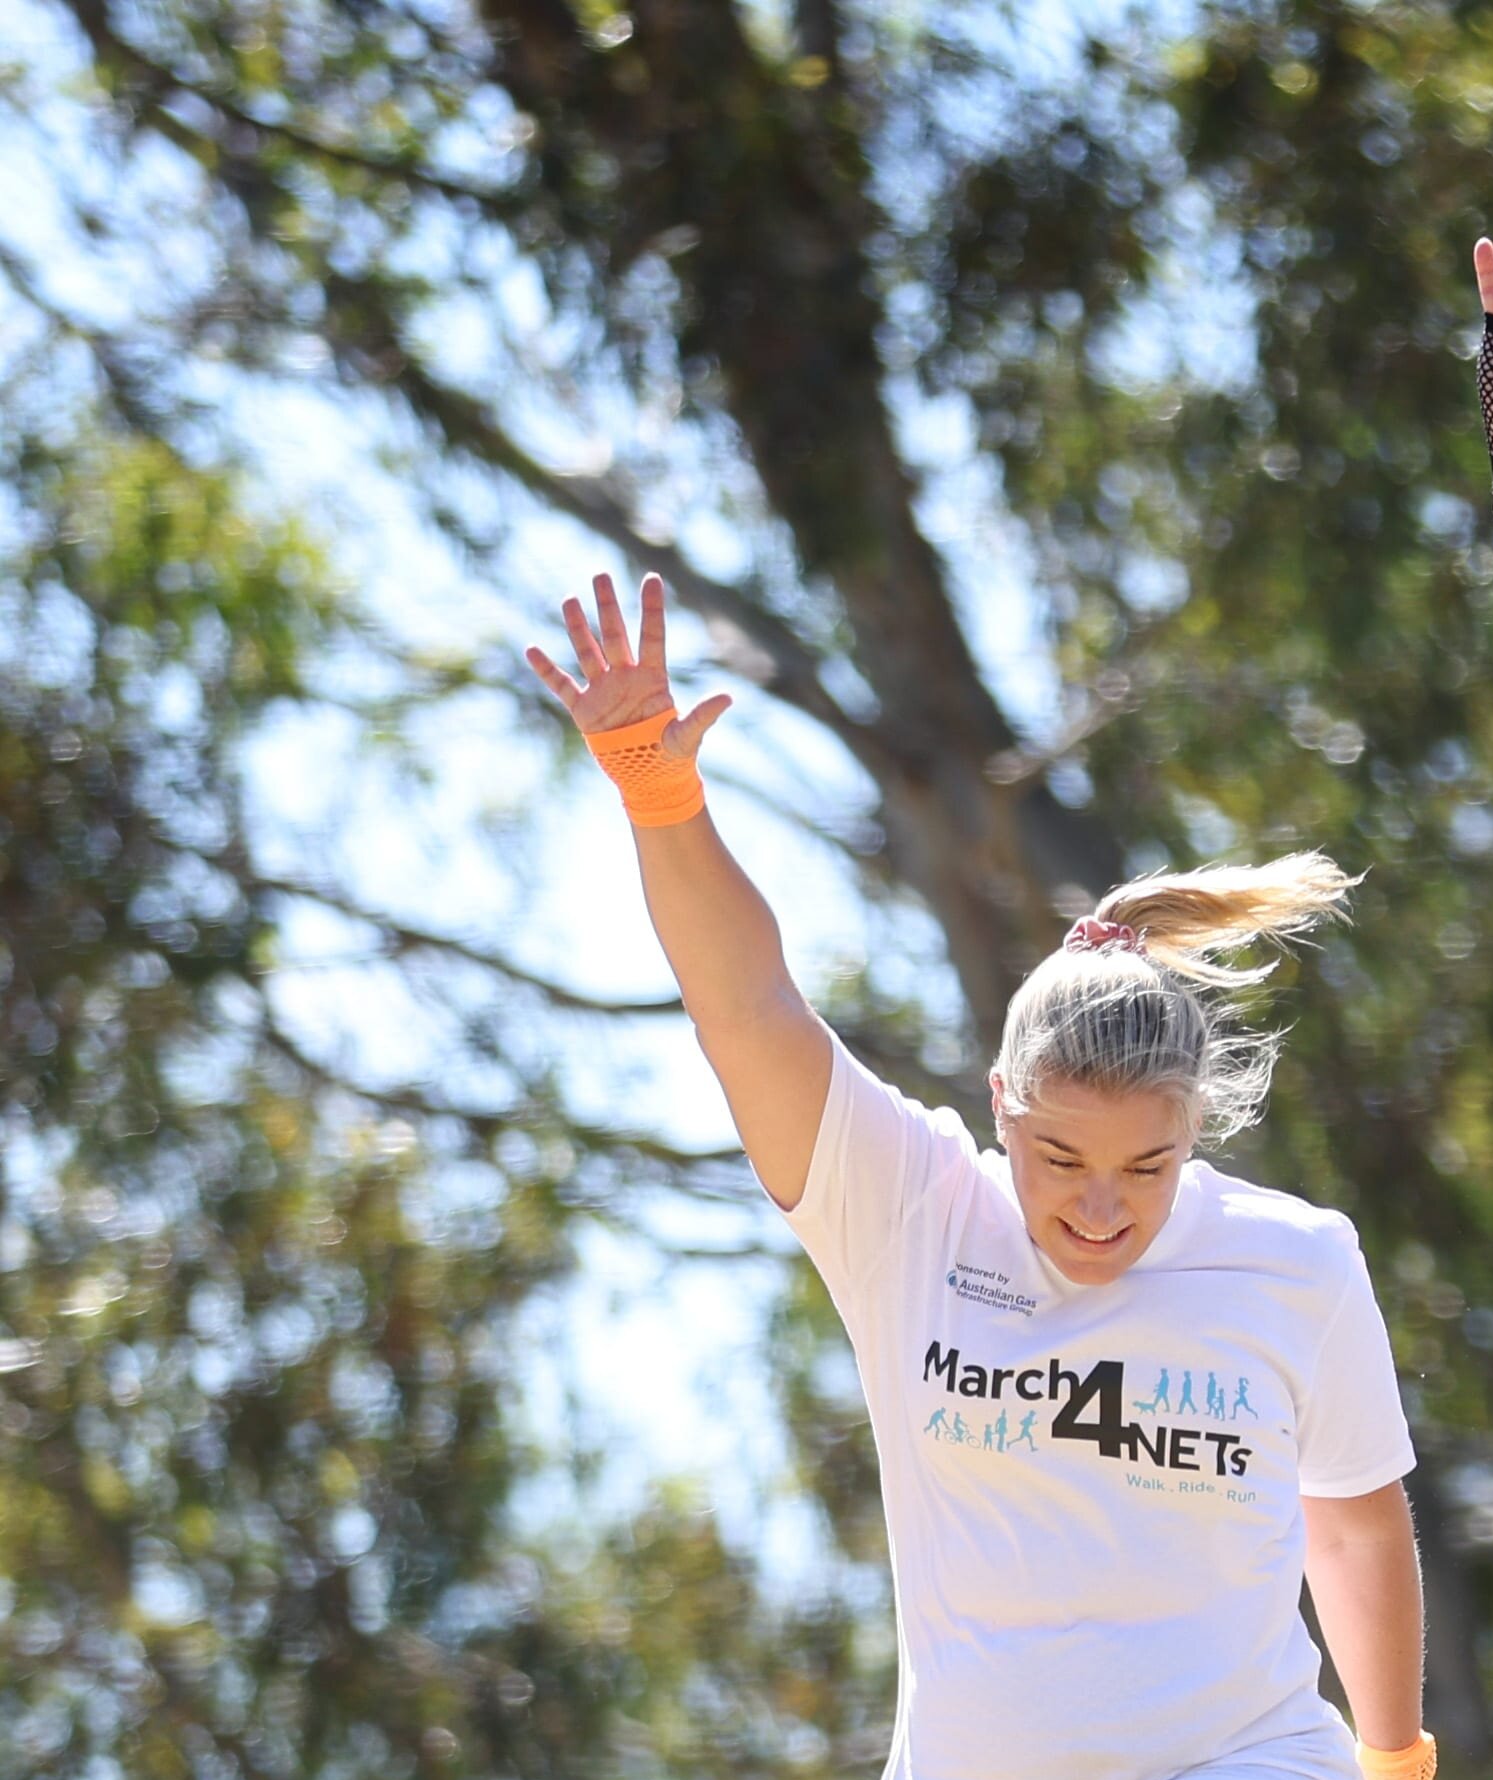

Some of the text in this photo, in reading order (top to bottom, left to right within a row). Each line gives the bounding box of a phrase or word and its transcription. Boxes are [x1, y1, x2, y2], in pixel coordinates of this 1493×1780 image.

[955, 1260, 1010, 1285] onsored by
[956, 1288, 1033, 1317] Infrastructure Group
[959, 1279, 1037, 1308] Australian Gas
[923, 1340, 1082, 1402] March
[1128, 1422, 1253, 1478] NETs
[1126, 1473, 1256, 1503] Walk Ride Run
